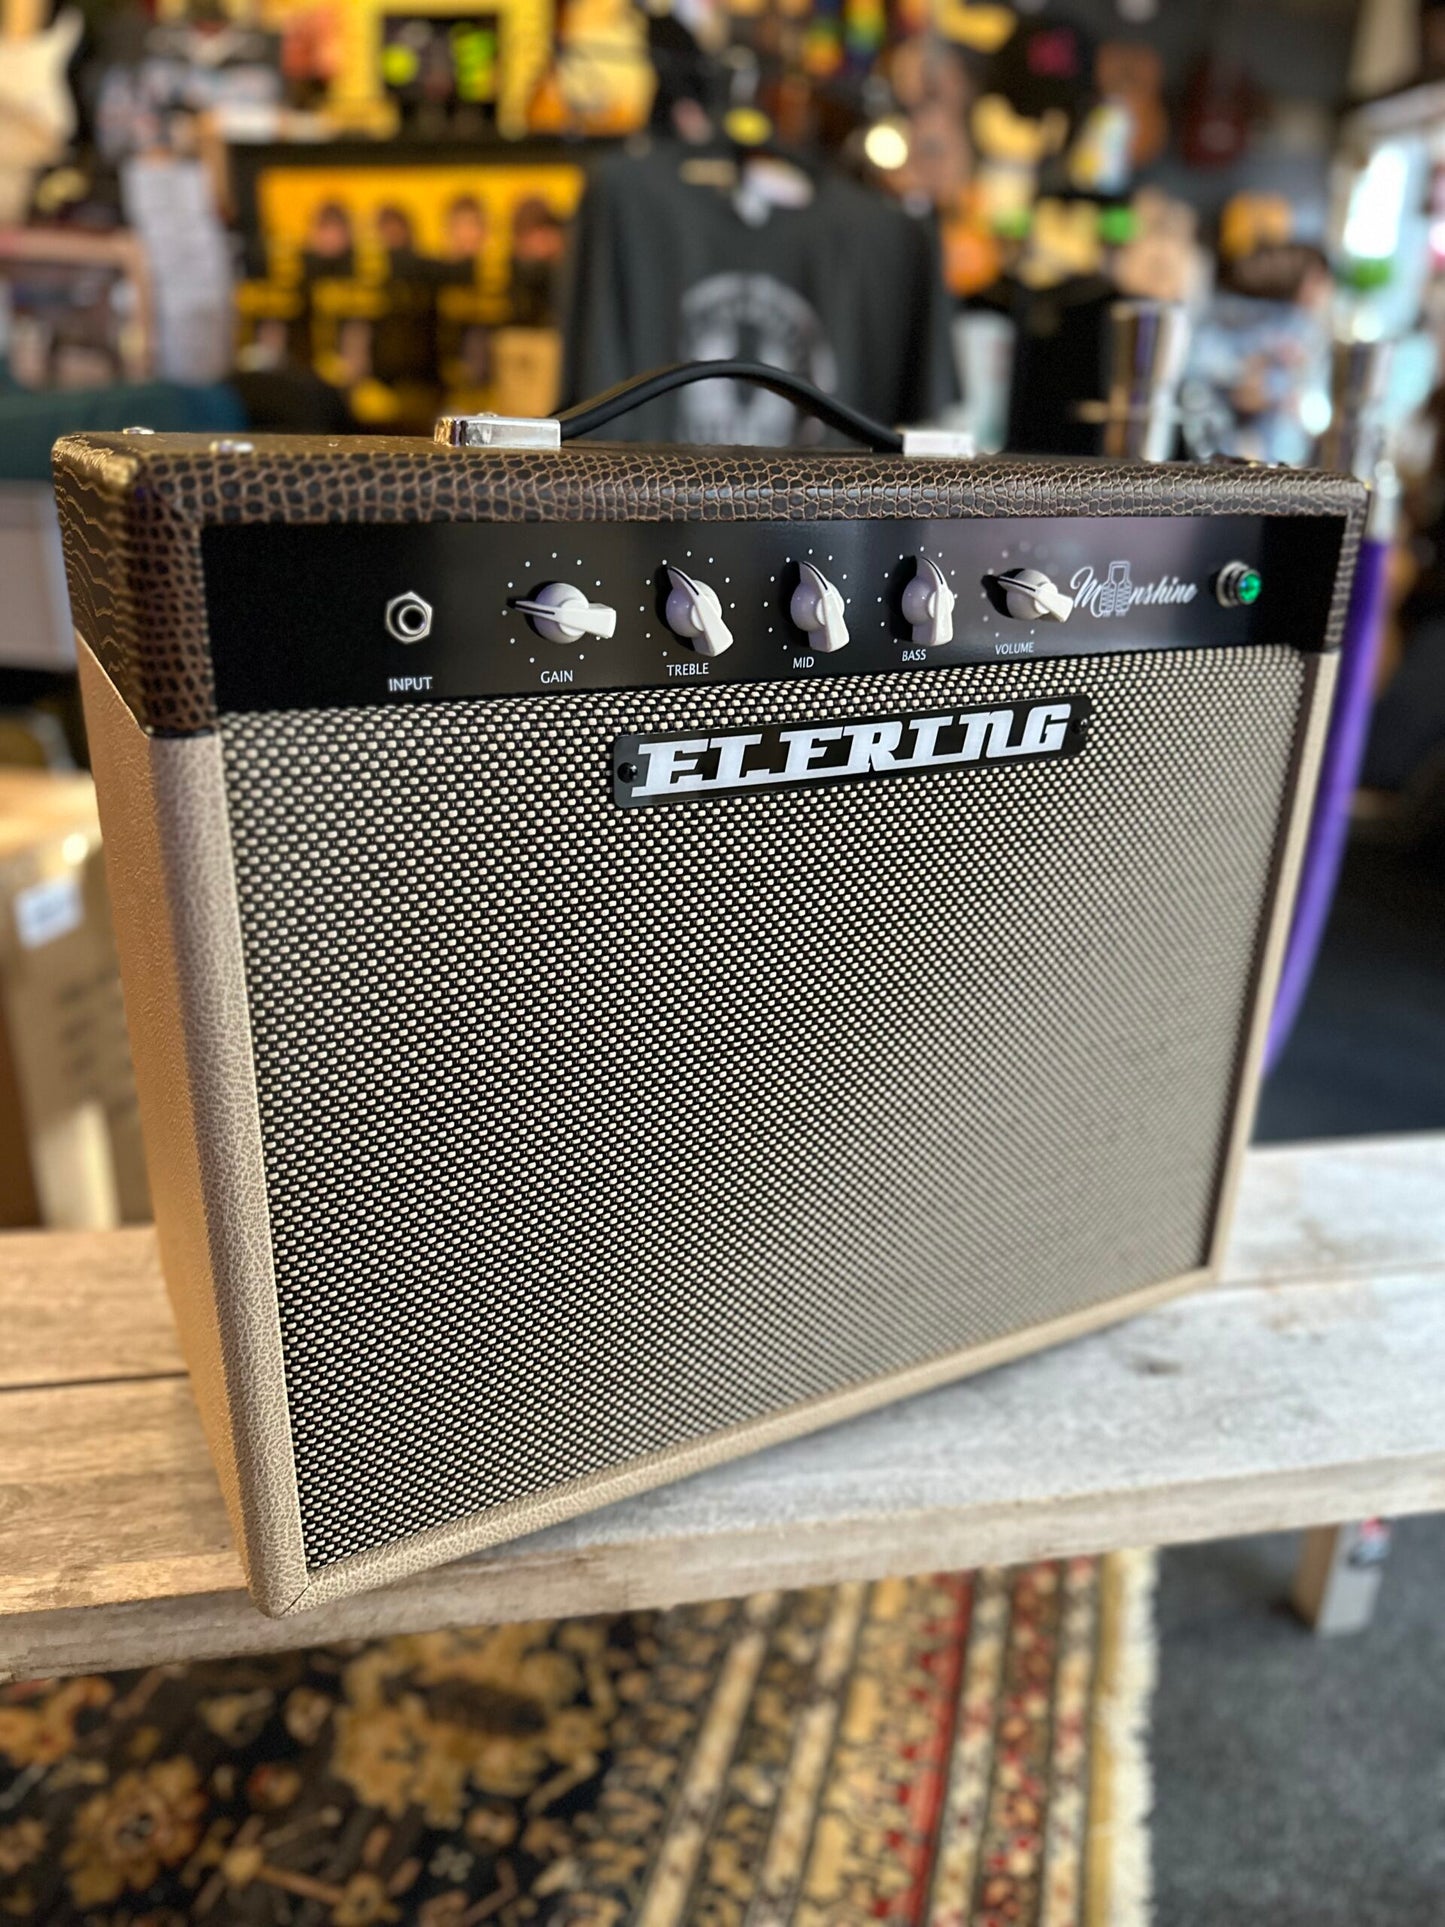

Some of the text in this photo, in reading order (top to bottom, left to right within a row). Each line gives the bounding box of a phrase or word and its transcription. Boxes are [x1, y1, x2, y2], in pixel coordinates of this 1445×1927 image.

[901, 649, 927, 662] BASS
[995, 642, 1035, 656] VOLUME
[666, 662, 709, 677] TREBLE
[792, 656, 815, 669] MID
[388, 676, 433, 692] INPUT
[540, 670, 574, 684] GAIN
[631, 703, 1072, 798] ELERING
